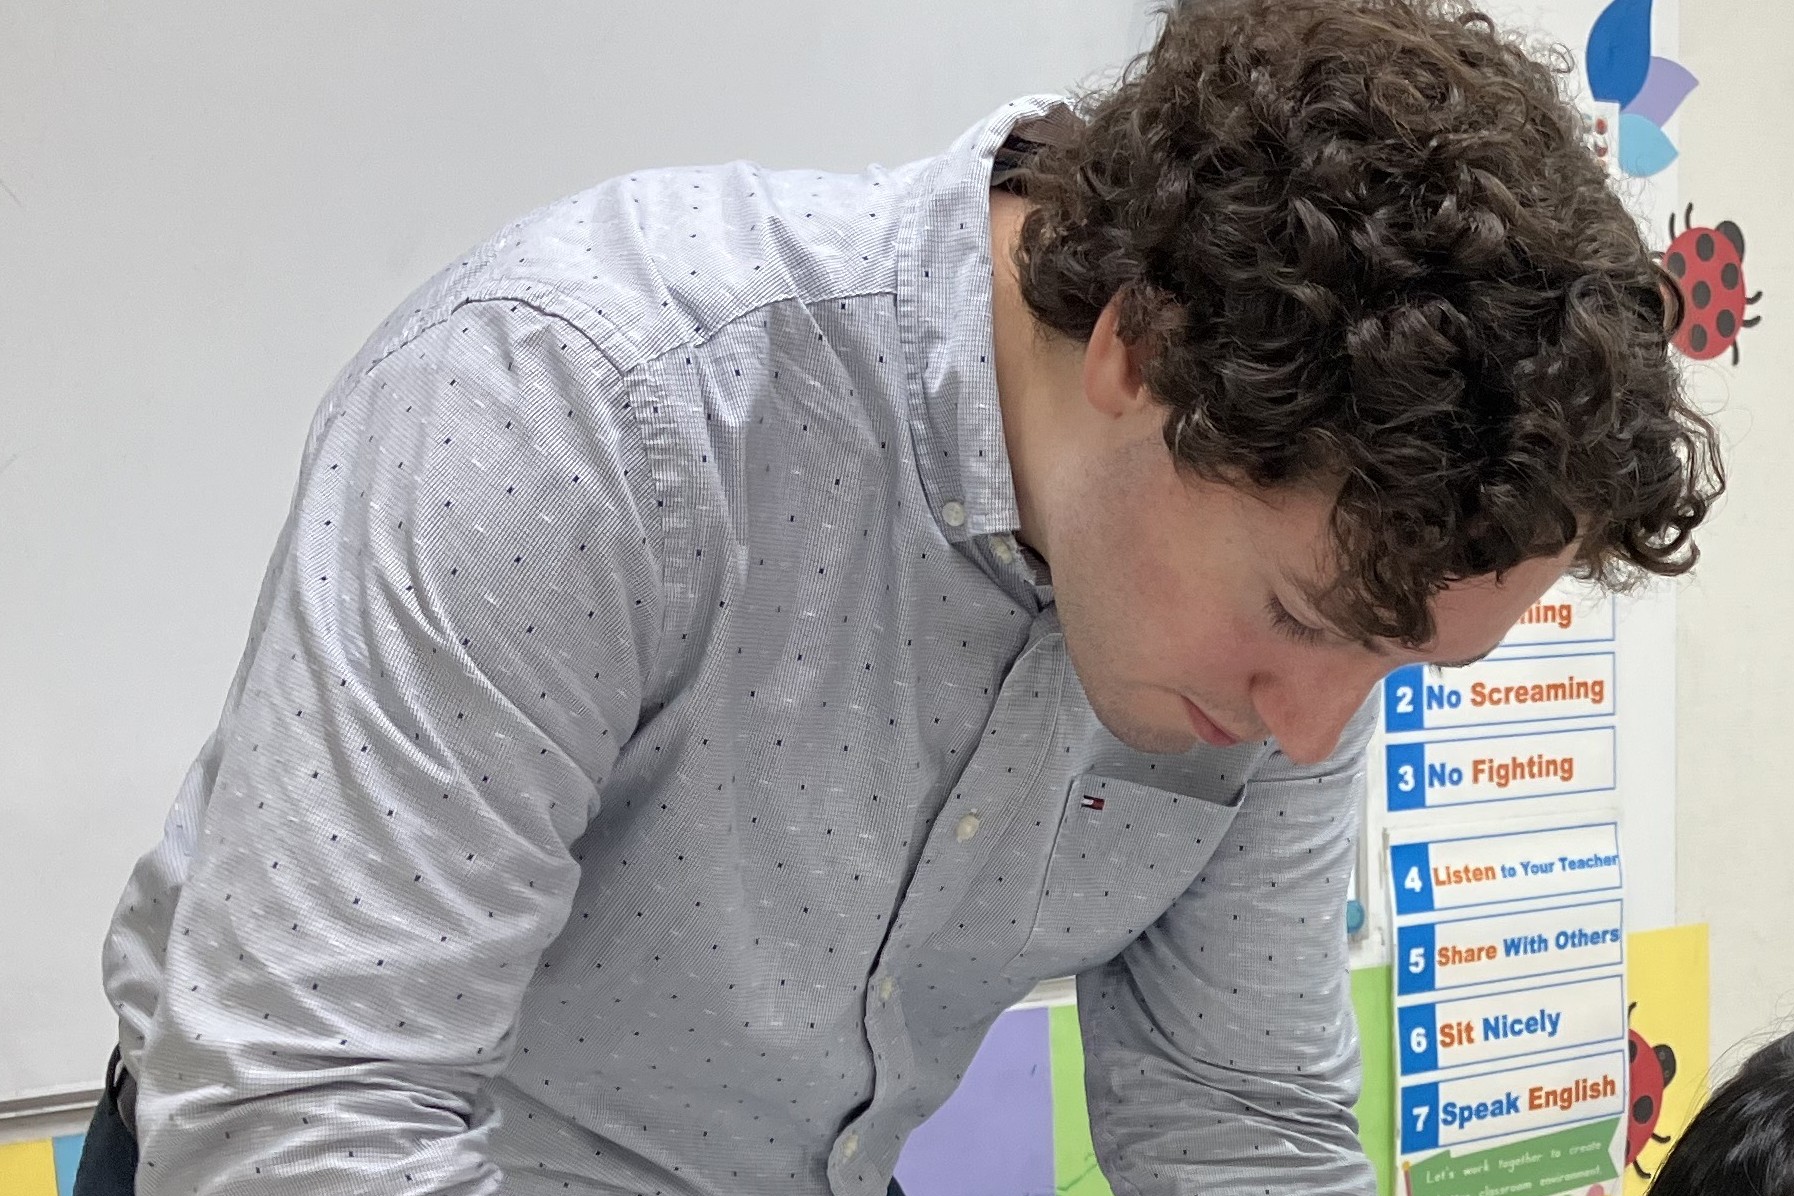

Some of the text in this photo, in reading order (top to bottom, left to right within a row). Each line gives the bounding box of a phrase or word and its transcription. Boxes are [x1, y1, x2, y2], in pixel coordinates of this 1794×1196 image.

[1396, 676, 1604, 713] 2 No Screaming
[1398, 754, 1574, 792] 3 No Fighting
[1405, 853, 1619, 892] 4 Listen to Your Teacher
[1409, 927, 1620, 973] 5 Share With Others
[1410, 1009, 1561, 1053] 6 Sit Nicely
[1413, 1075, 1616, 1132] 7 Speak English
[1426, 1142, 1601, 1184] Let's work together to create
